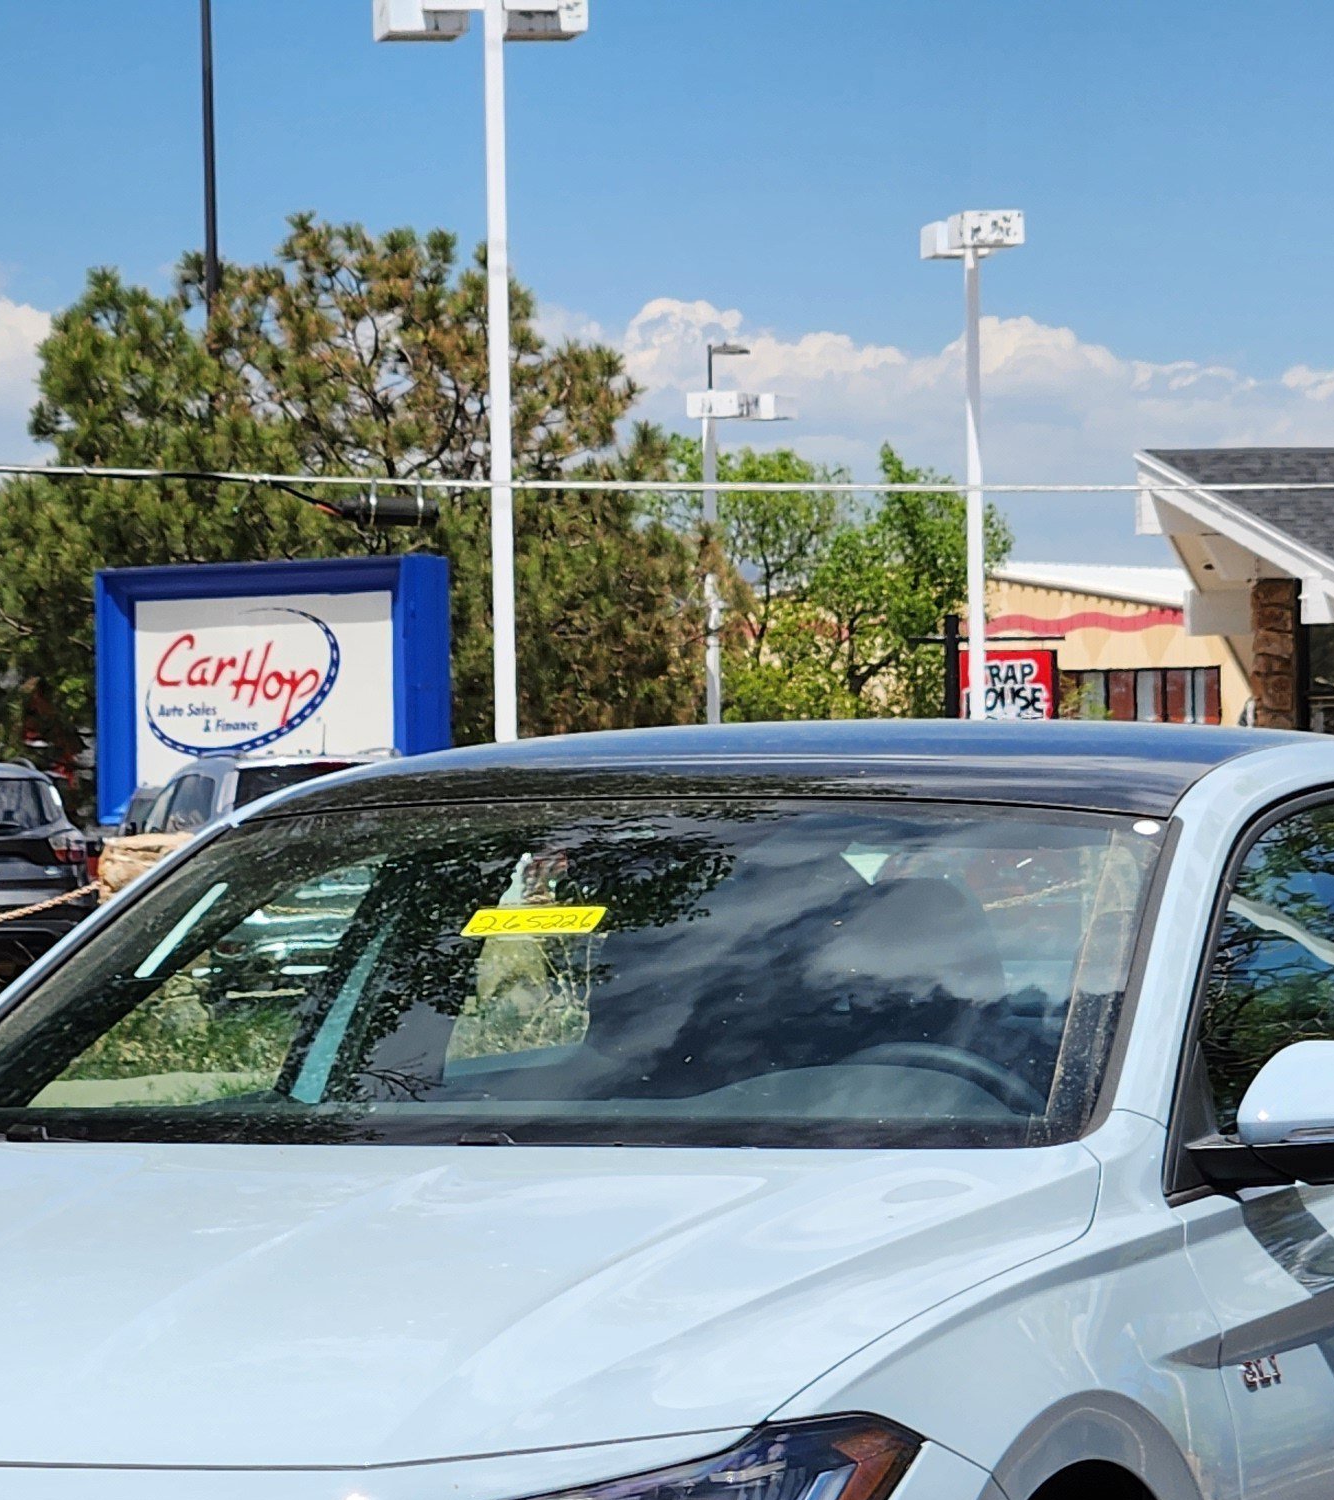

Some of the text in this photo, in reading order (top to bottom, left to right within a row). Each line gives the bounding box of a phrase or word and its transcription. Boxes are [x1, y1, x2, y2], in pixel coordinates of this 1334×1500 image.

[156, 634, 319, 727] CarHop
[187, 702, 217, 717] Sales
[966, 687, 1043, 713] OUSE
